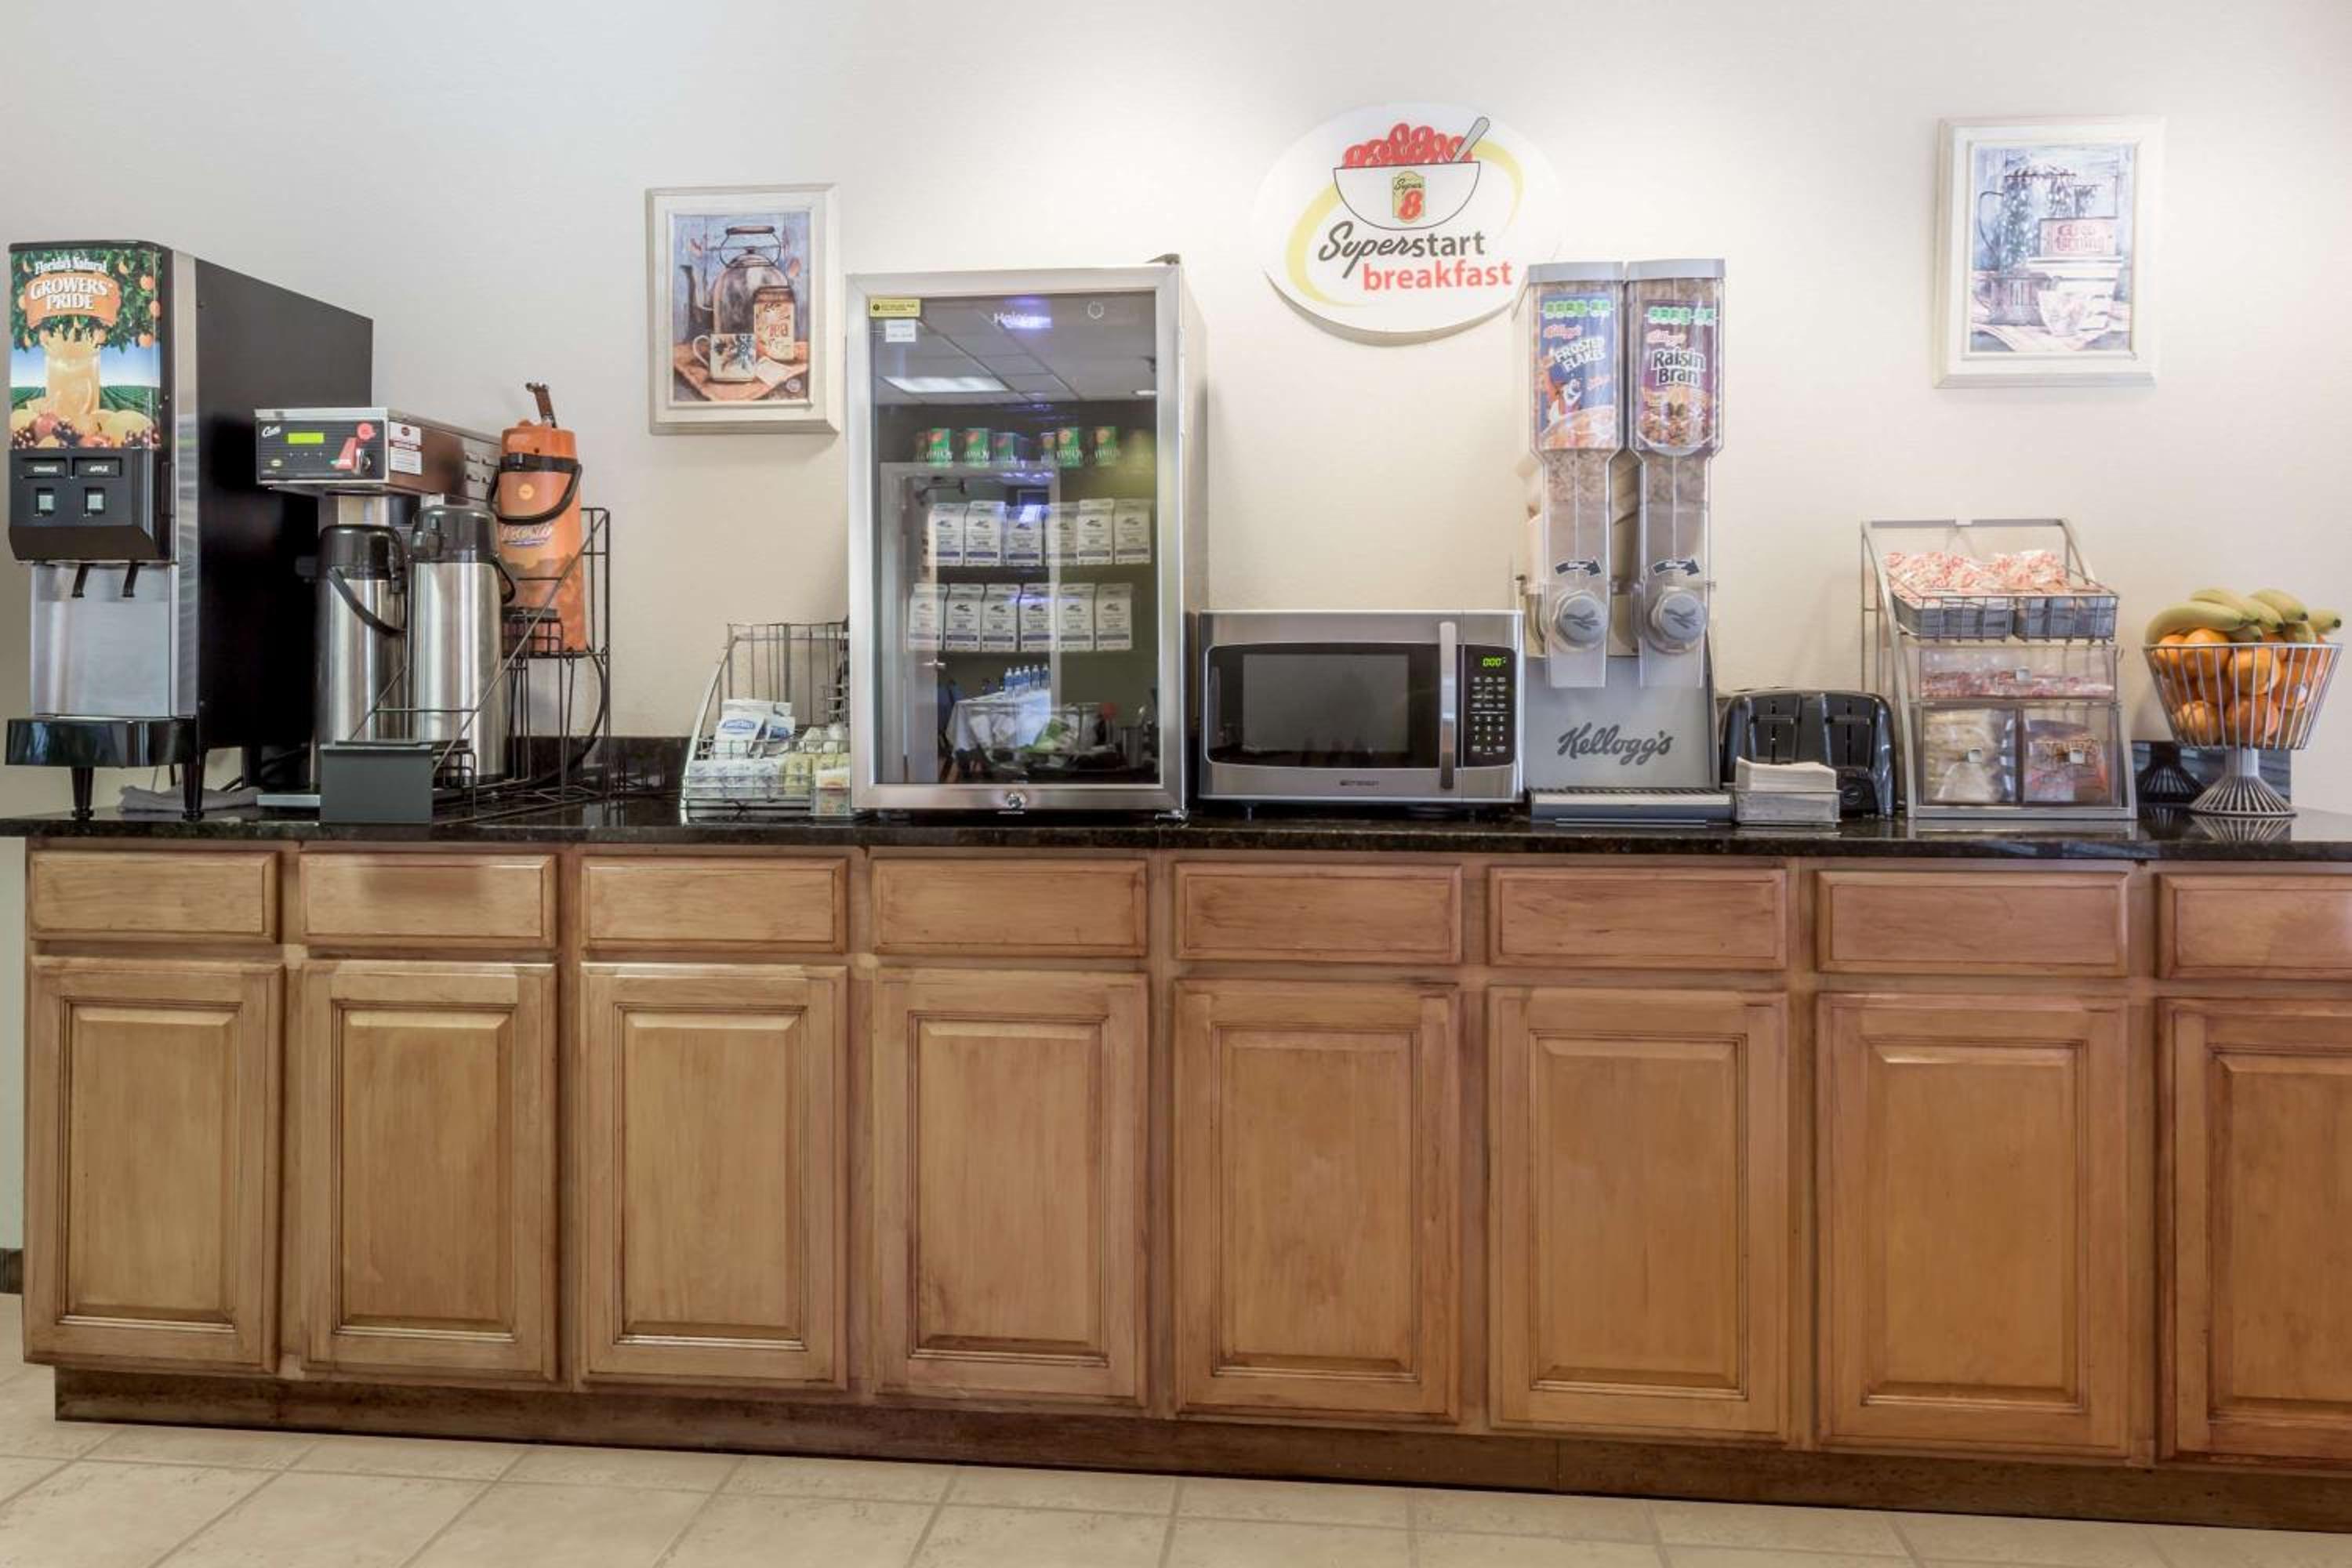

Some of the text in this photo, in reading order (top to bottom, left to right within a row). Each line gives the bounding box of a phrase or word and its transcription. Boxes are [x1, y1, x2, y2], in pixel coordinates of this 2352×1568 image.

[1399, 191, 1423, 220] 8
[1318, 220, 1486, 279] Superstart
[1363, 259, 1513, 290] breakfast
[46, 292, 94, 311] PRIDE
[1653, 347, 1705, 369] Raisin
[1658, 368, 1700, 384] Bran
[1557, 722, 1674, 766] Kellogg's
